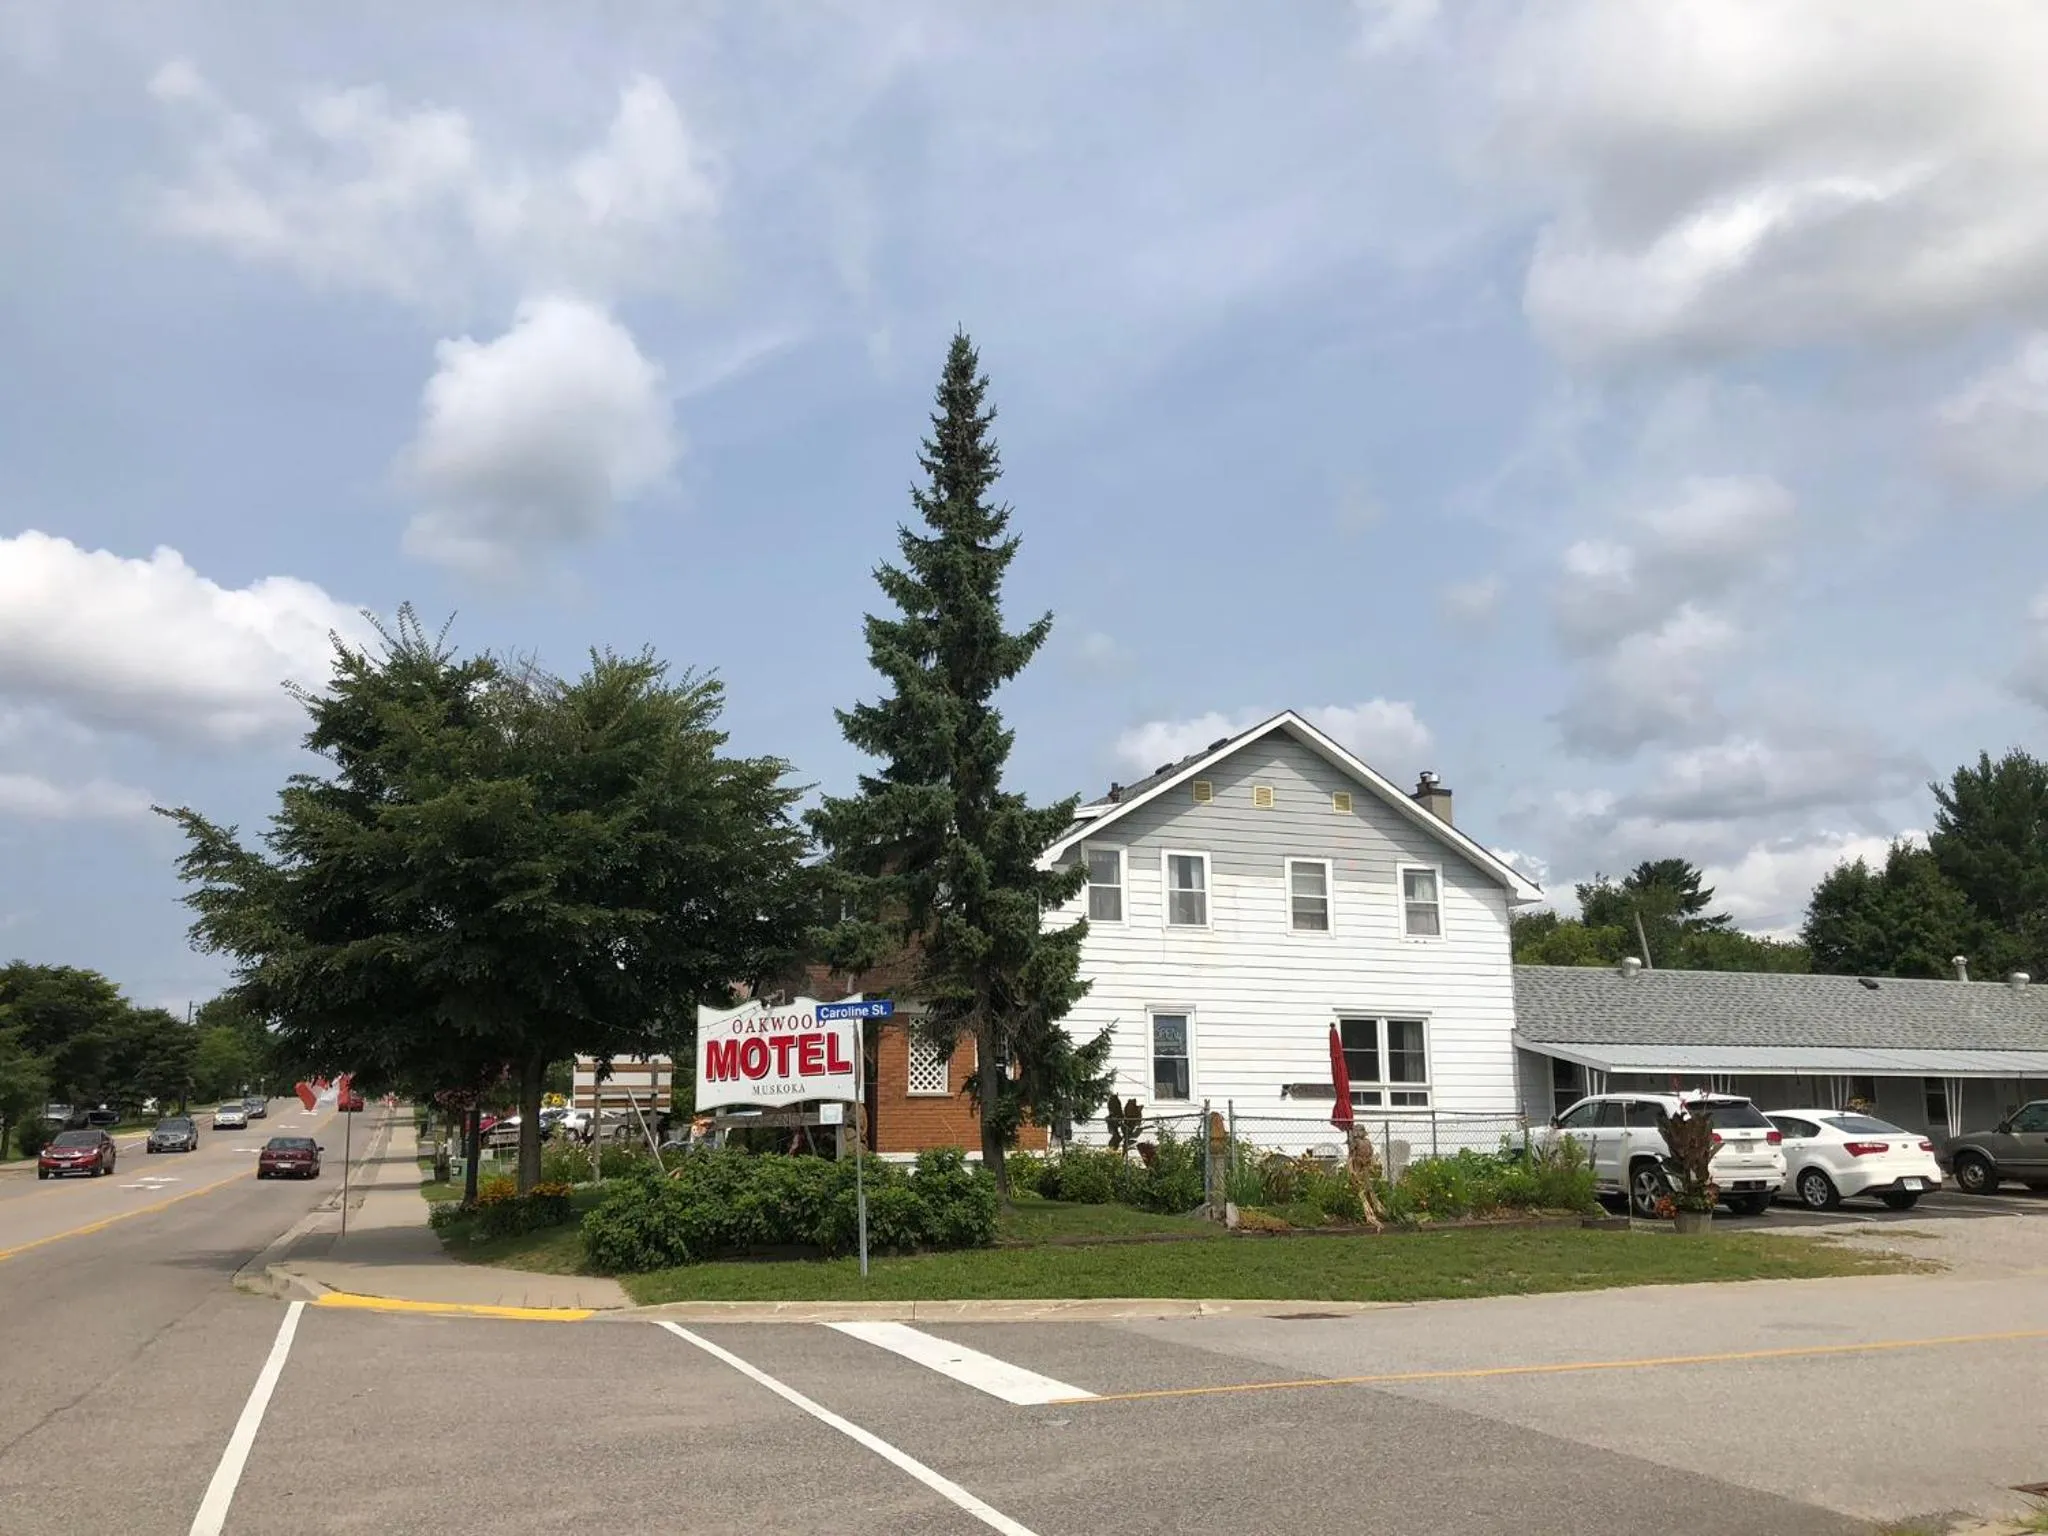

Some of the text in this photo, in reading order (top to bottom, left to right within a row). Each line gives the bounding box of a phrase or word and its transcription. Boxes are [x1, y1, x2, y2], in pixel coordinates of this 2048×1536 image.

[821, 1004, 888, 1019] Caroline St.
[705, 1032, 853, 1083] MOTEL
[752, 1083, 806, 1096] MUSKOKA
